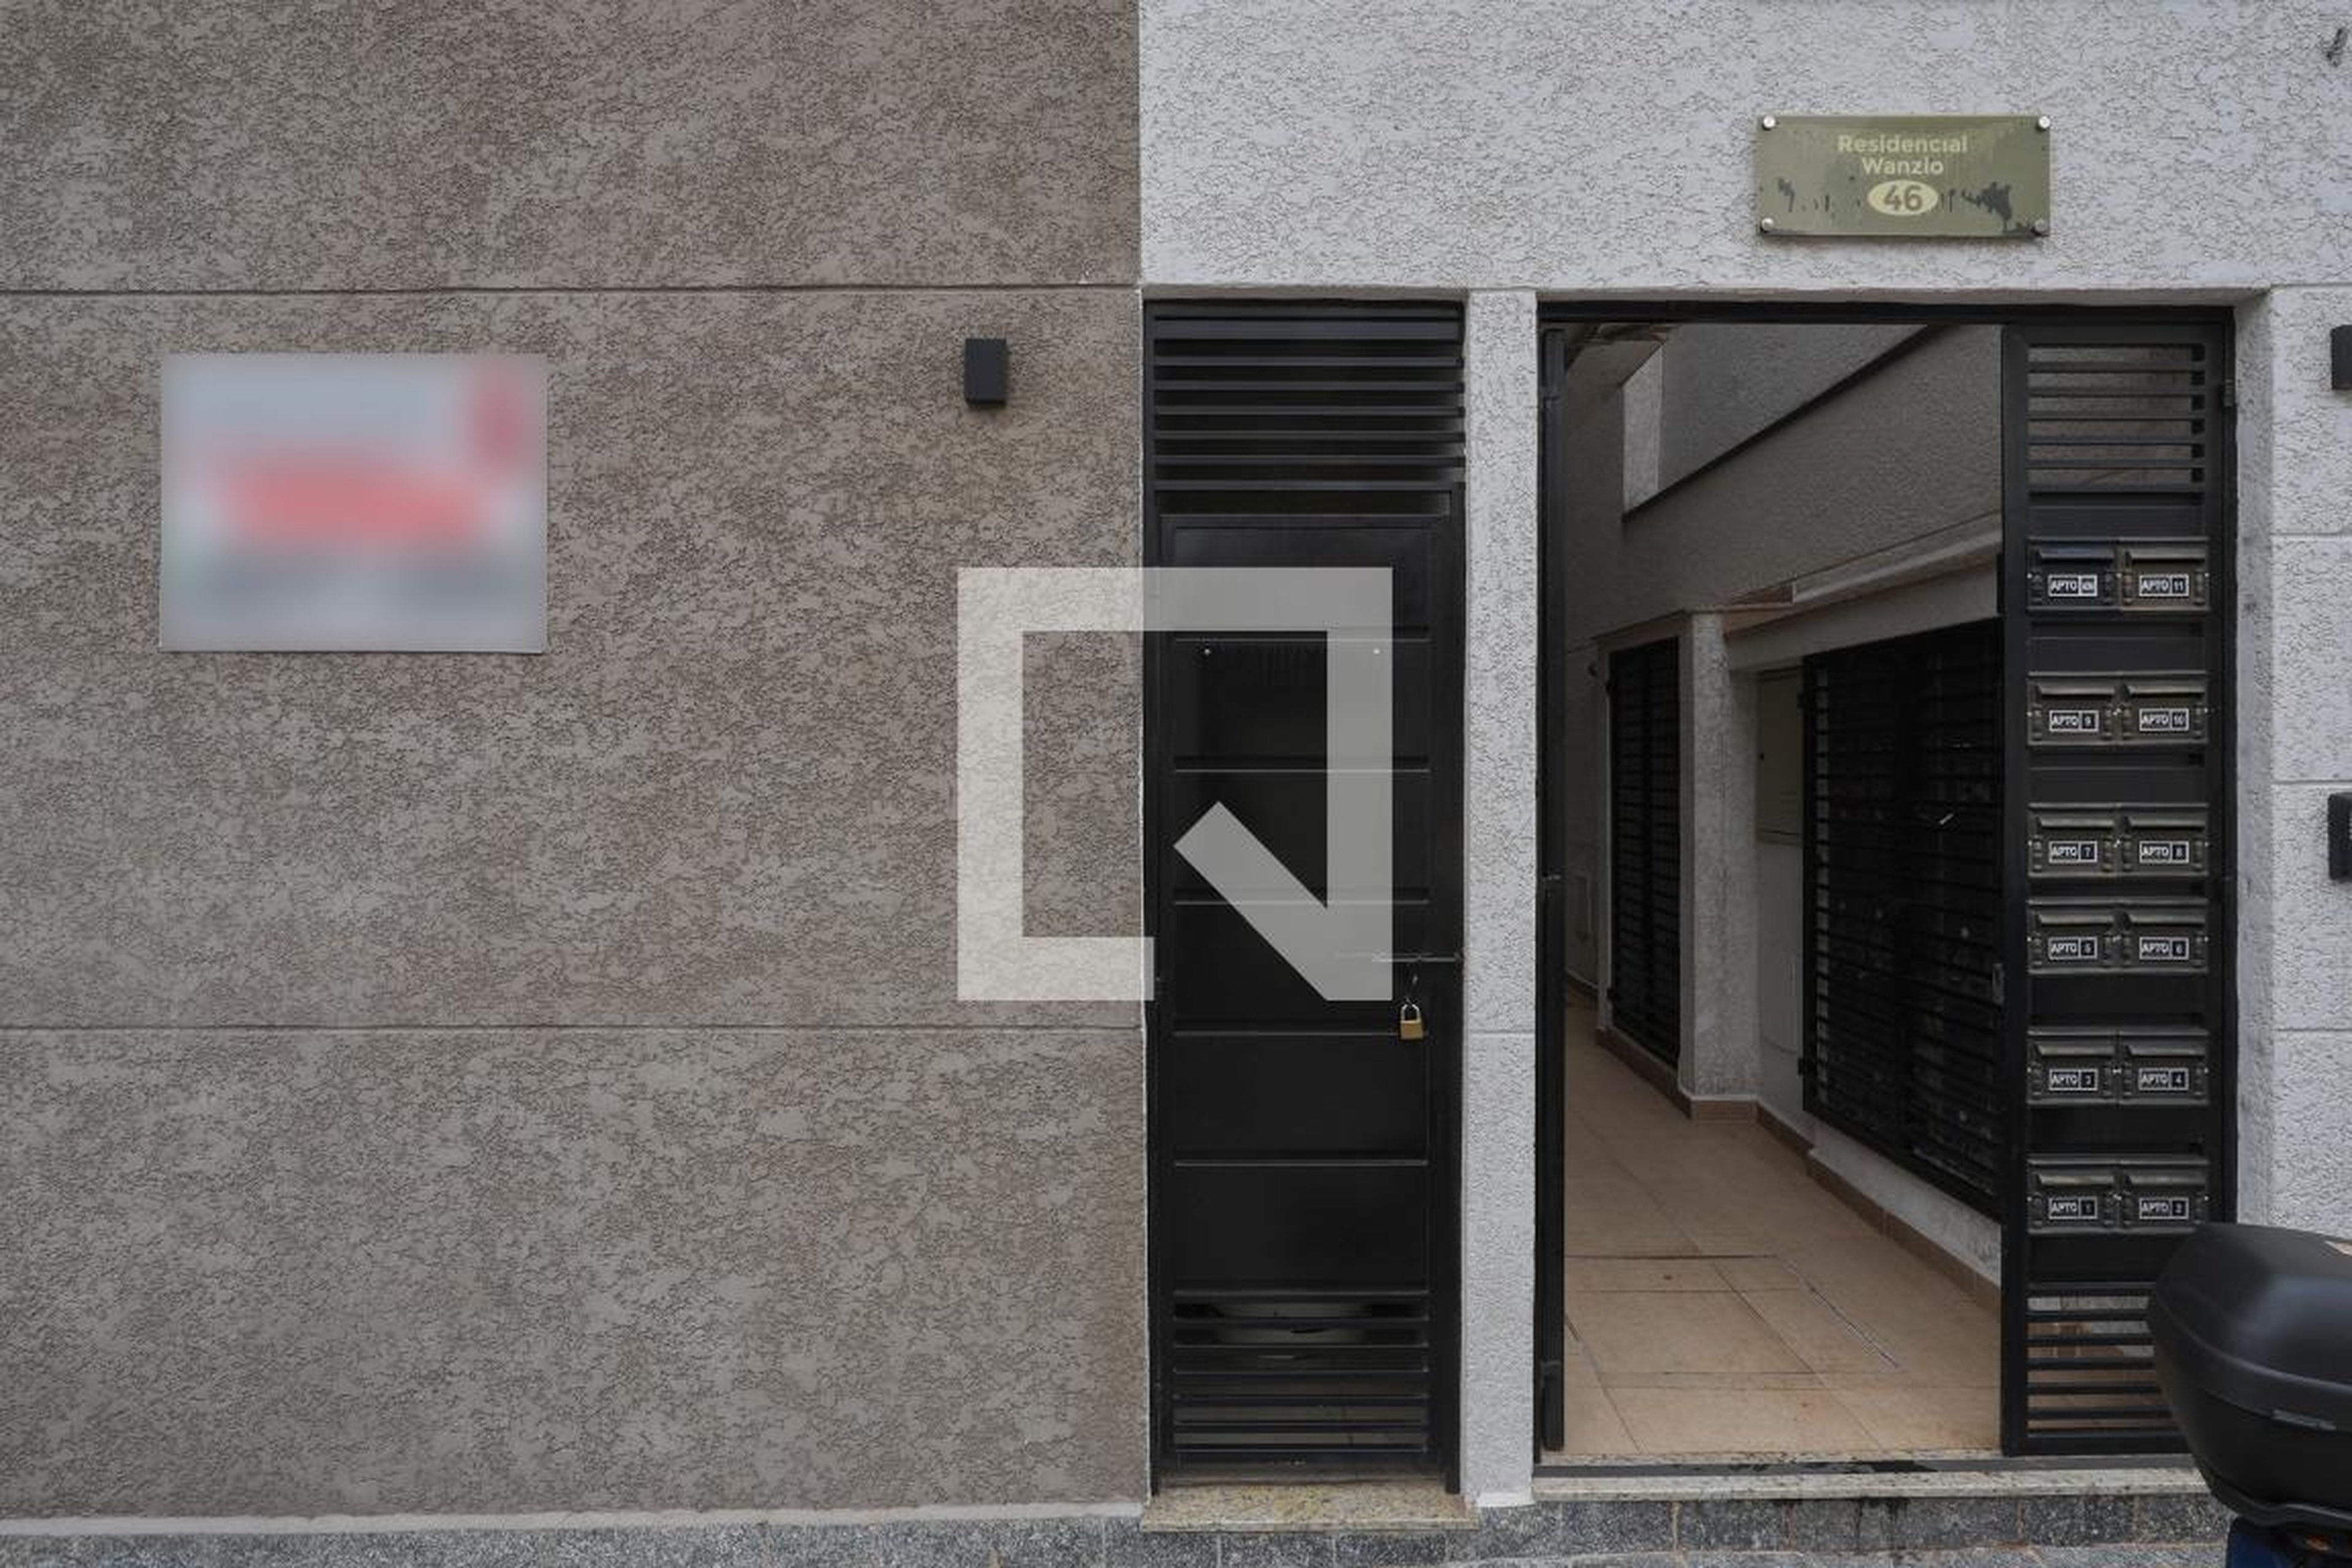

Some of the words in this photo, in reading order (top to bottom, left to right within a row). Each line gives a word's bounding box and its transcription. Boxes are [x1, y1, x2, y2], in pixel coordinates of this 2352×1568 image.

[1838, 134, 1967, 153] Residencial
[1883, 185, 1923, 211] 46
[2051, 580, 2077, 591] APTO
[2141, 579, 2169, 591] APTO
[2173, 581, 2184, 590] 11
[2051, 715, 2078, 726] APTO
[2141, 714, 2169, 725] APTO
[2051, 846, 2077, 856] APTO
[2084, 846, 2091, 857] 7
[2141, 846, 2169, 856] APTO
[2051, 943, 2077, 952] APTO
[2141, 943, 2169, 953] APTO
[2051, 1074, 2077, 1084] APTO
[2140, 1074, 2168, 1084] APTO
[2051, 1202, 2077, 1212] APTO
[2141, 1202, 2169, 1212] APTO
